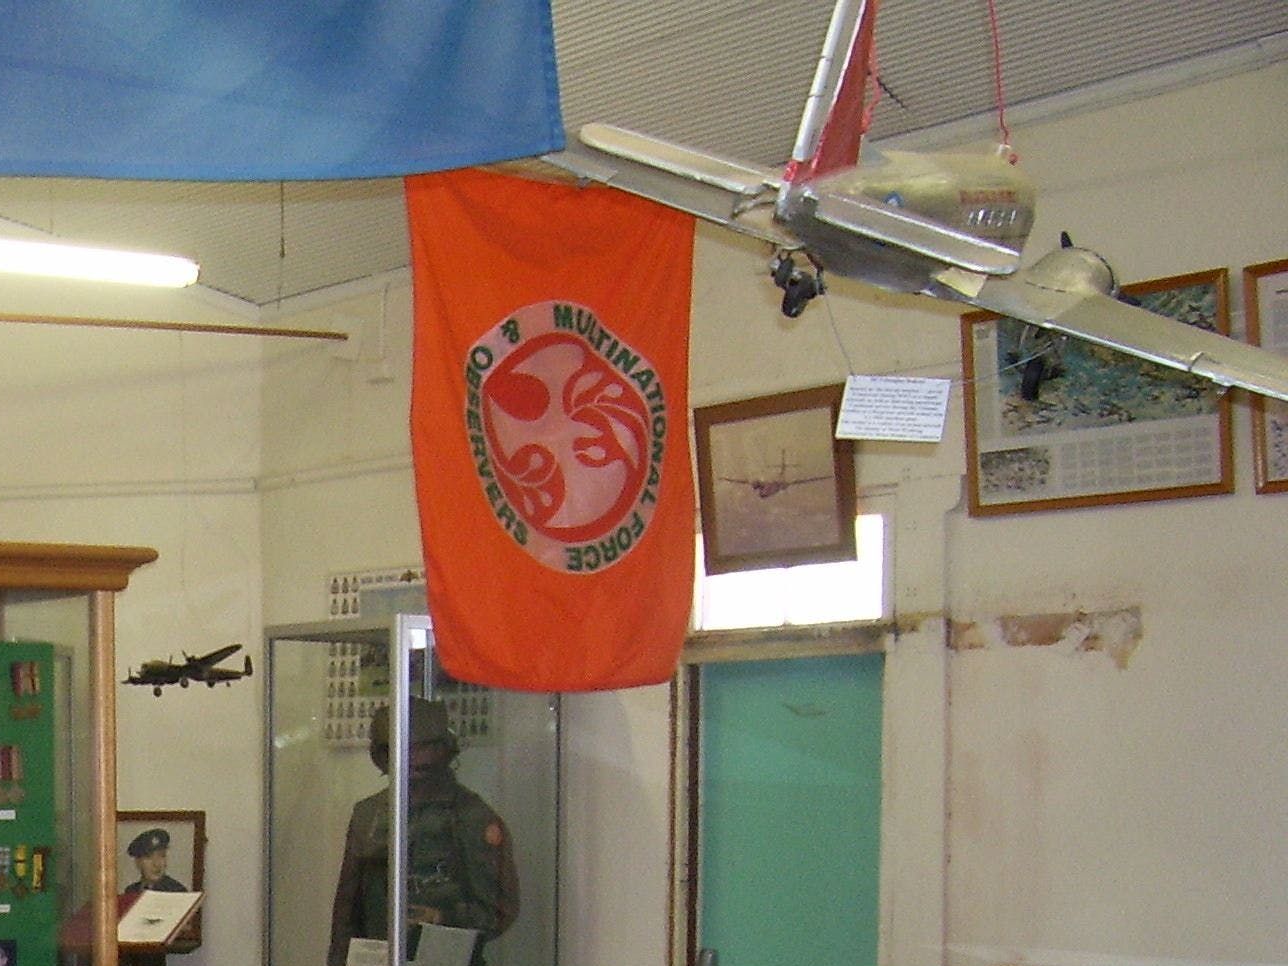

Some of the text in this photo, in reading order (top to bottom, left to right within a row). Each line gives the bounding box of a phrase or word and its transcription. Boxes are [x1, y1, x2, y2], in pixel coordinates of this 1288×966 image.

[466, 345, 528, 546] OBSERVERS
[553, 303, 666, 505] MULTINATIONAL
[565, 511, 645, 572] FORCE
